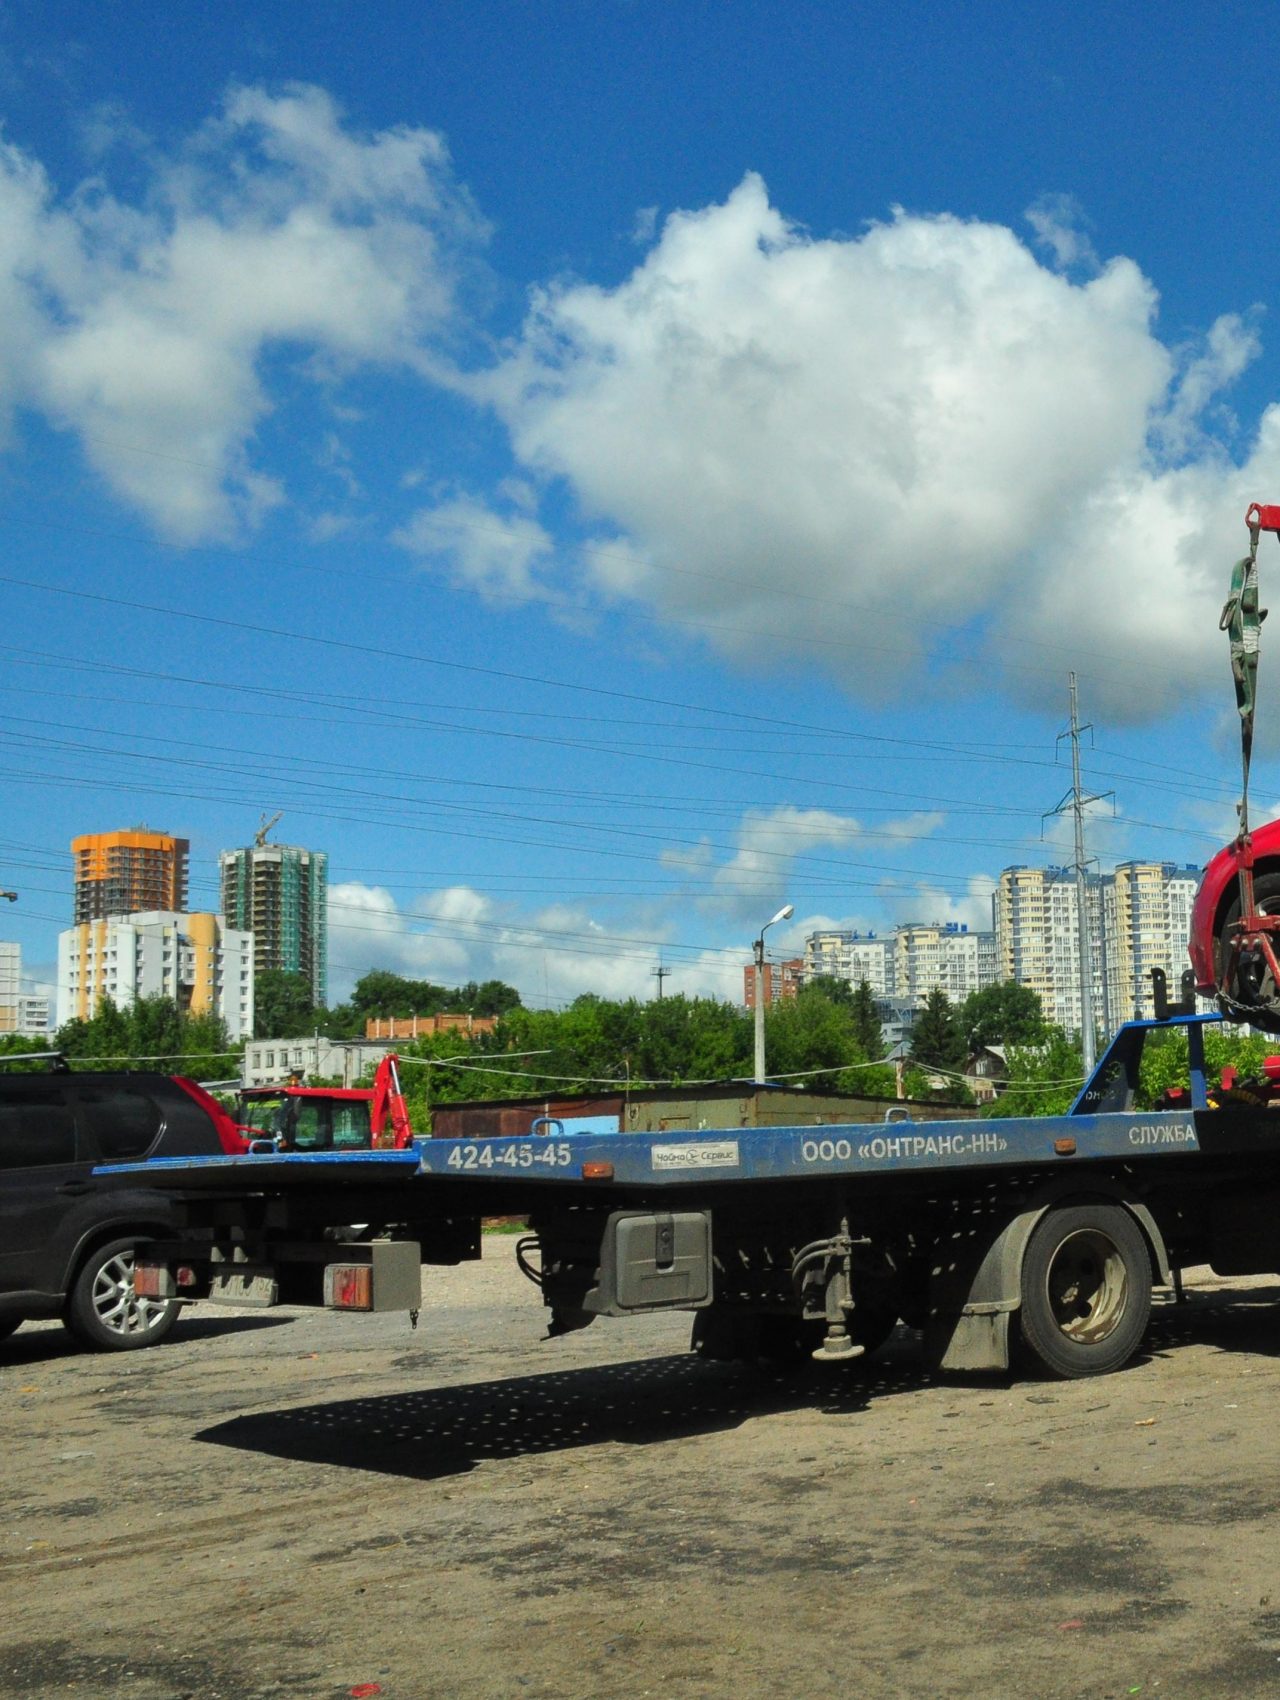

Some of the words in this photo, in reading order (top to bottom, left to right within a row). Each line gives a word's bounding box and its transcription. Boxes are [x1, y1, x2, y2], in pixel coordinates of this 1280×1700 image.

[802, 1140, 851, 1162] ООО
[858, 1133, 1008, 1159] «ОНТРАНС-НН»
[1128, 1124, 1196, 1145] СЛУЖБА
[447, 1143, 572, 1169] 424-45-45
